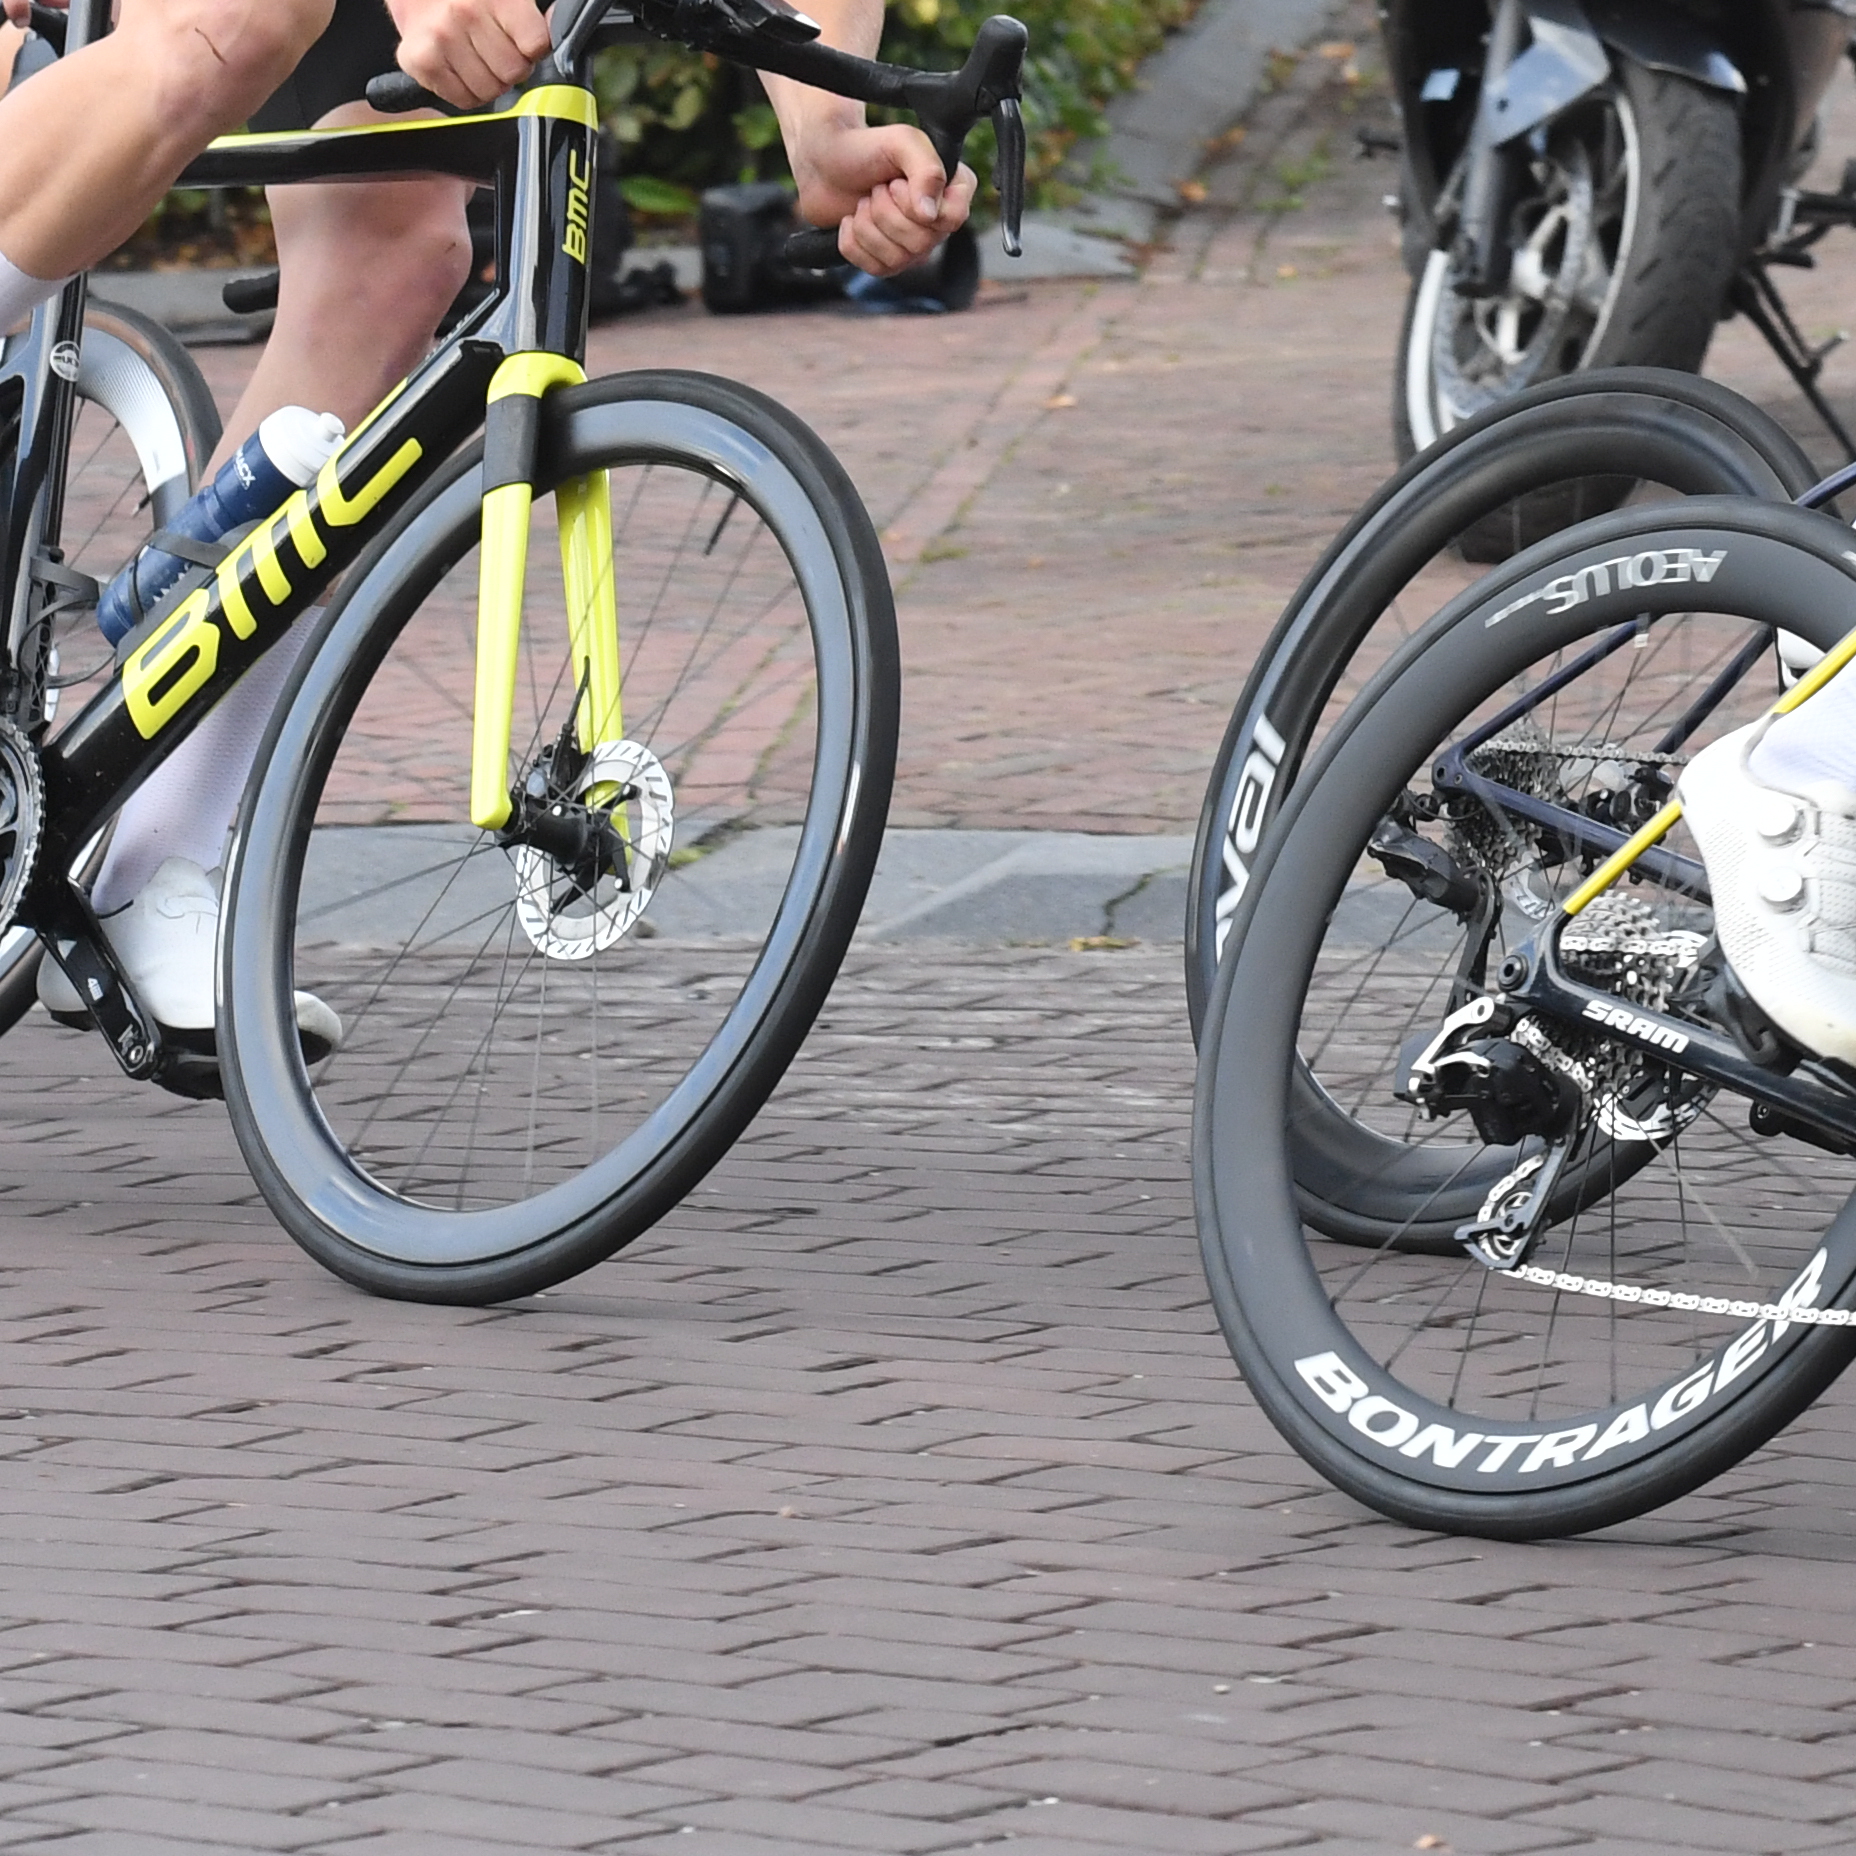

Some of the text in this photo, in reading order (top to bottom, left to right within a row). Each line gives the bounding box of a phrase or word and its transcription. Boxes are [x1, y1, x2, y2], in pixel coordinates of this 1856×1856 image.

[561, 148, 591, 266] BMC
[122, 435, 425, 743] BMC
[1581, 997, 1690, 1055] SRAM
[1293, 1245, 1830, 1475] BONTRAGER
